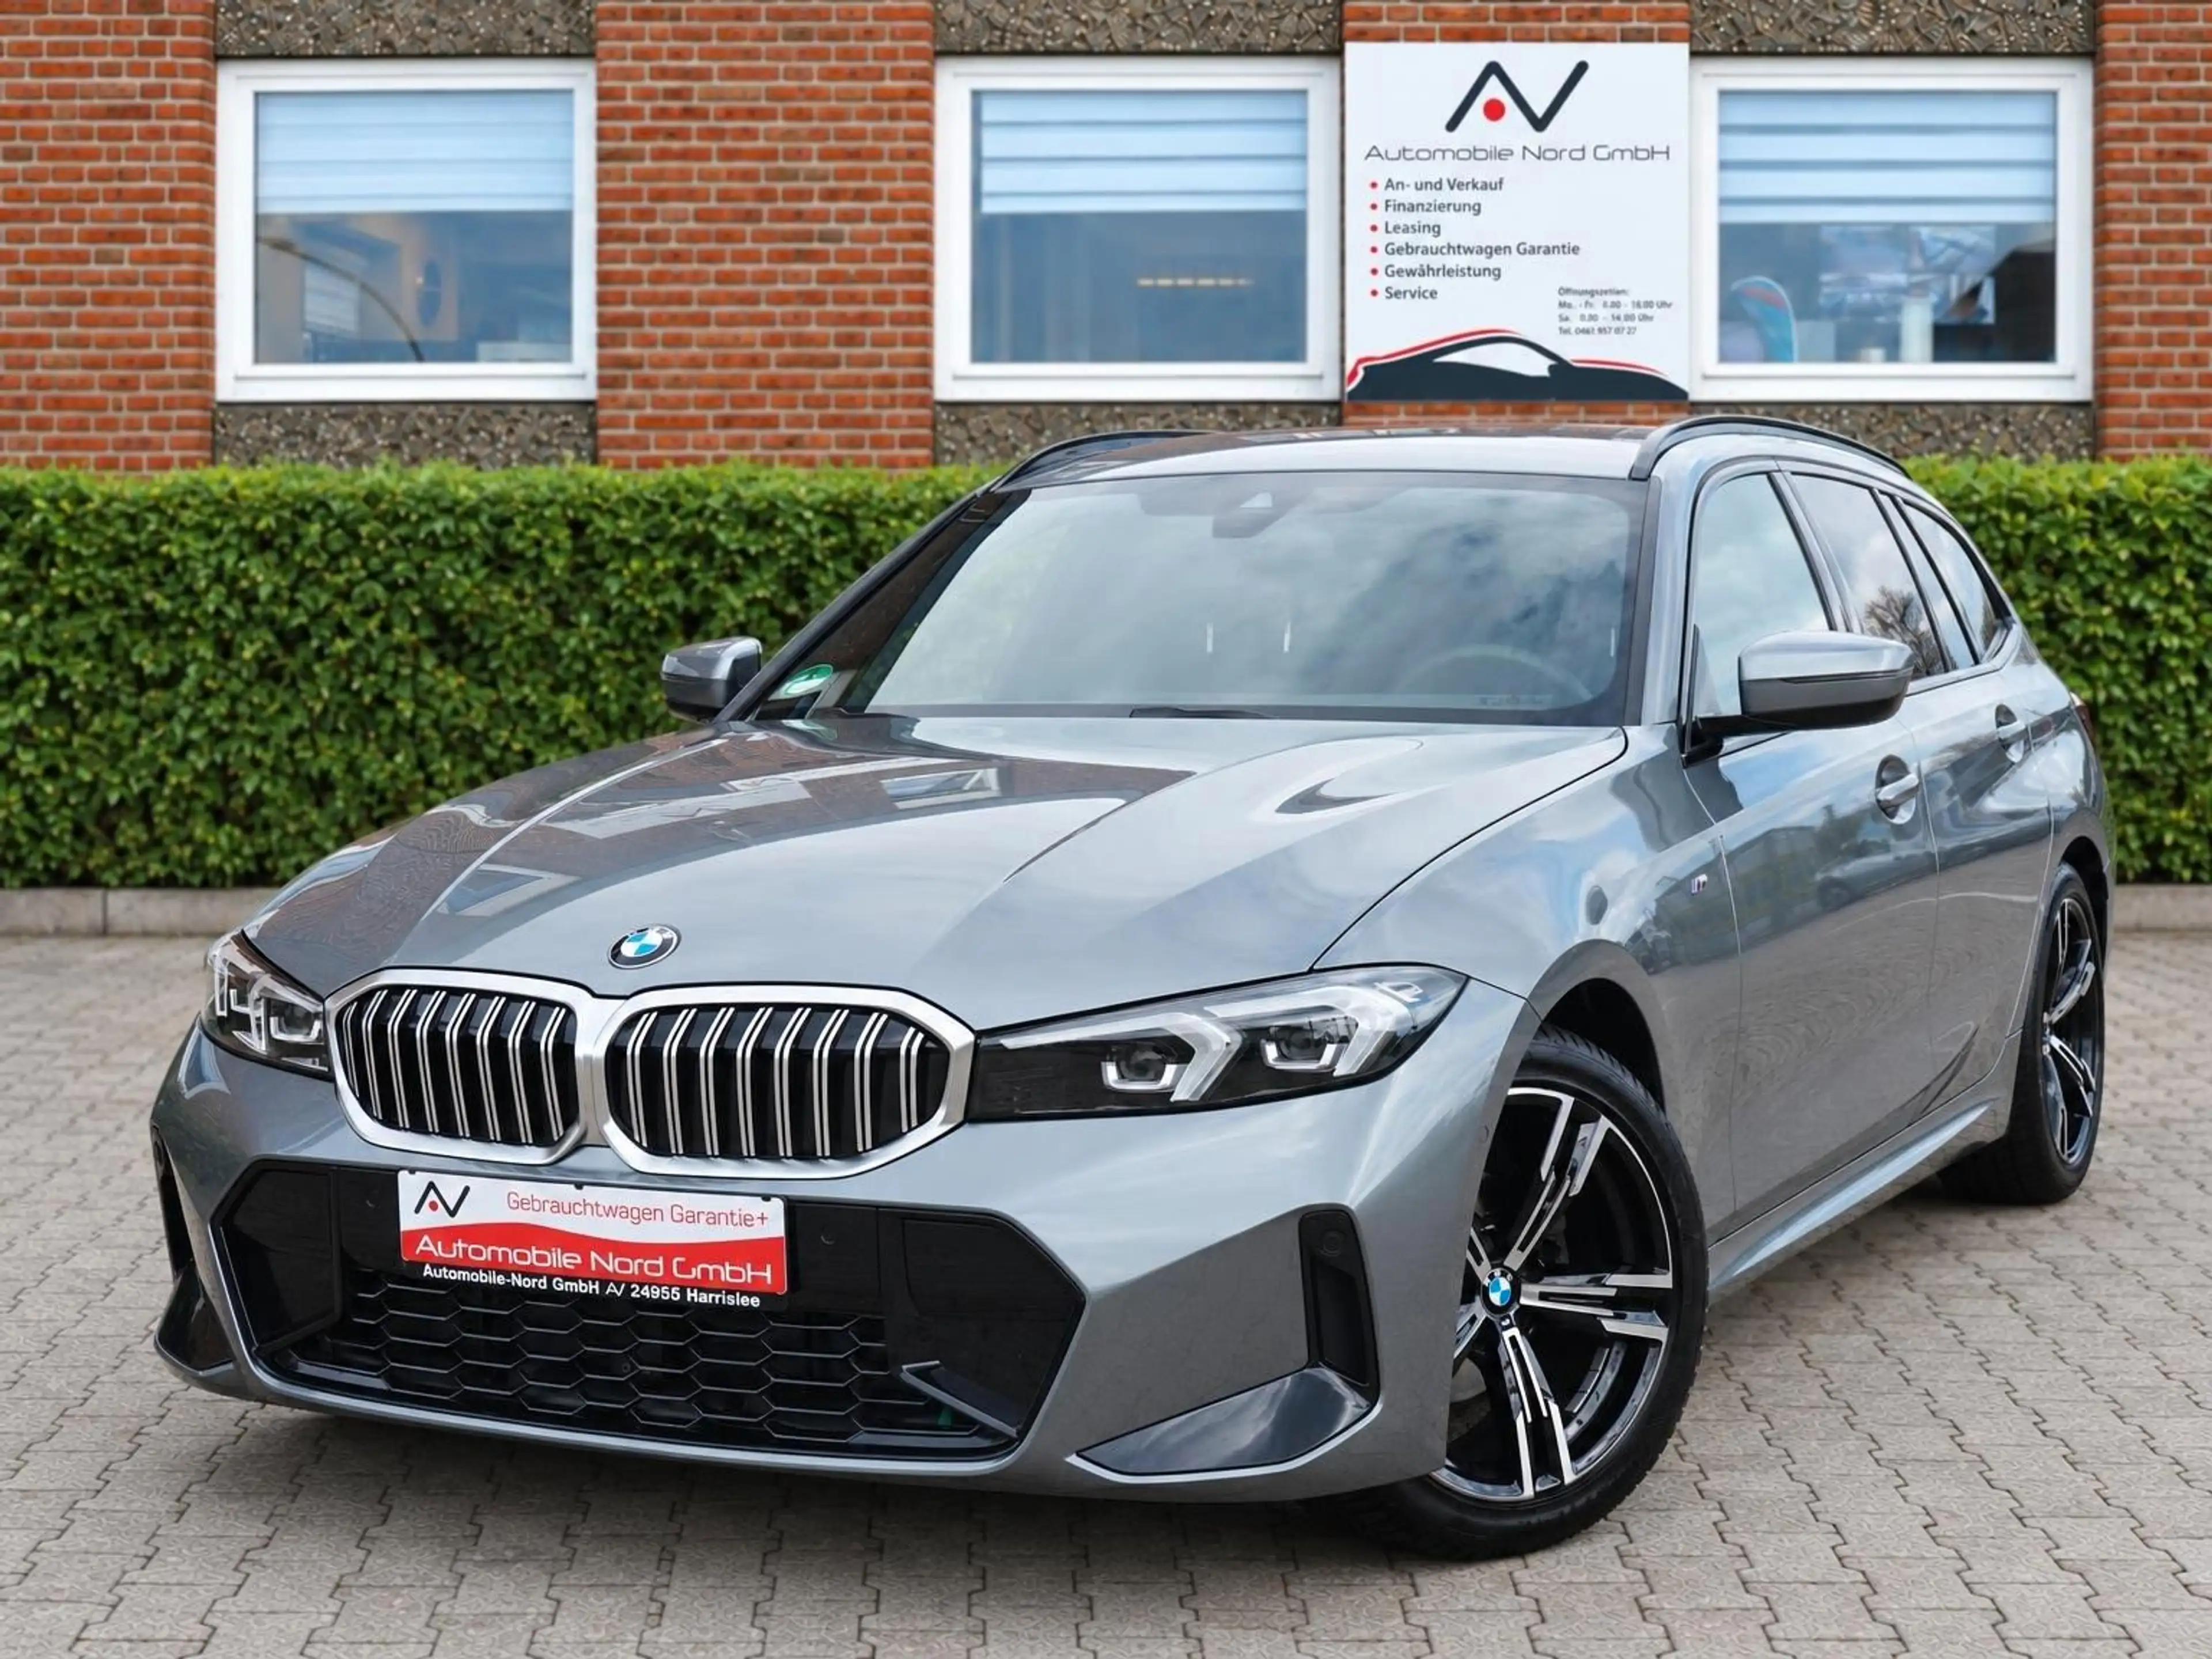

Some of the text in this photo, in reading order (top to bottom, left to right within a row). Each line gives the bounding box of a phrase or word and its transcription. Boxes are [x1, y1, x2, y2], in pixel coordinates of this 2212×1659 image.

[1364, 145, 1670, 161] Automobile Nord GmbH
[1384, 177, 1504, 191] An- und Verkauf
[1384, 198, 1482, 217] Finanzierung
[1384, 221, 1441, 238] Leasing
[1384, 241, 1580, 259] Gebrauchtwagen Garantie
[1384, 263, 1502, 281] Gewährleistung
[1384, 285, 1438, 300] Service
[506, 1190, 768, 1228] Gebrauchtwagen Garantie+
[415, 1234, 772, 1285] Automobile Nord GmbH
[423, 1263, 547, 1290] Automobile-Nord
[552, 1277, 600, 1295] GmbH
[630, 1283, 681, 1302] 24955
[686, 1289, 760, 1308] Harrislee
